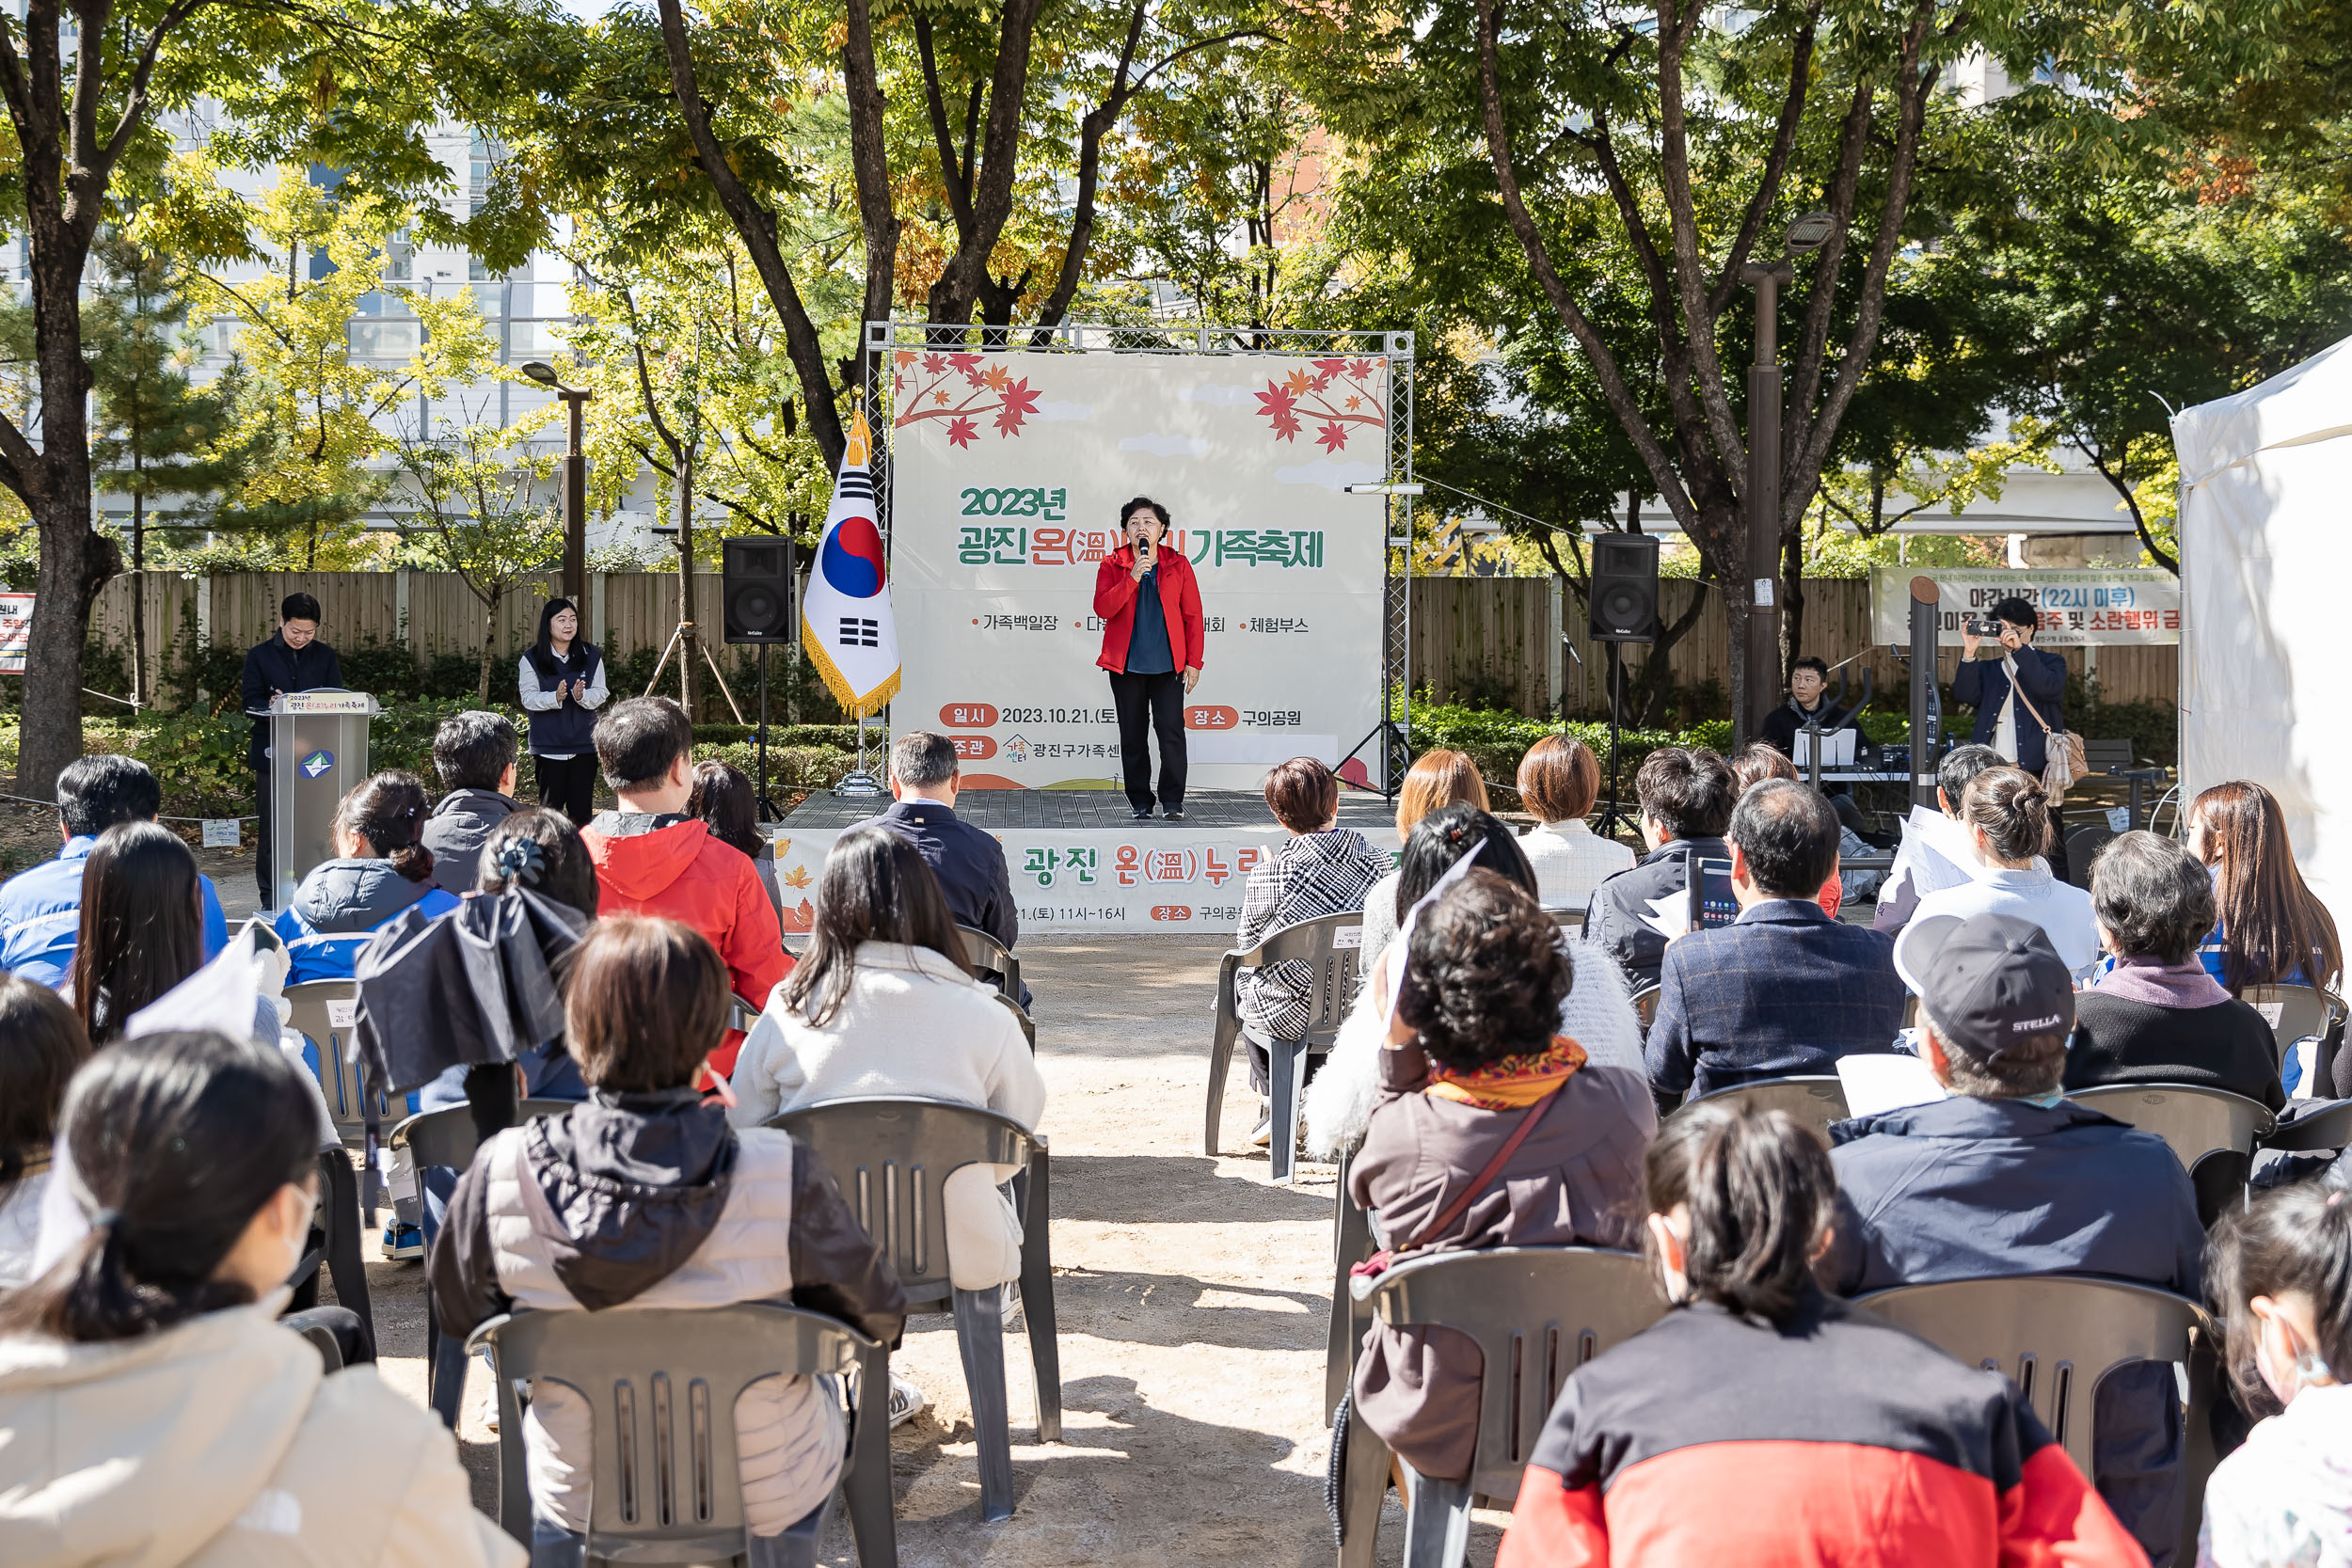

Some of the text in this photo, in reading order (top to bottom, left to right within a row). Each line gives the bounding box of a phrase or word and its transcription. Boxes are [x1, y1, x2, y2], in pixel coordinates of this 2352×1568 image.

[960, 487, 1067, 521] 2023년
[958, 527, 1027, 565] 광진
[1190, 529, 1325, 568] 가족축제
[983, 614, 1059, 631] 가족백일장
[1249, 617, 1309, 633] 체험부스
[2069, 611, 2085, 631] 및
[2090, 610, 2159, 631] 소란행위
[953, 707, 985, 723] 일시
[1242, 710, 1301, 726] 구의공원
[1024, 847, 1096, 885] 광진
[1059, 907, 1125, 921] 11시~16시
[2012, 1013, 2062, 1033] STELLA
